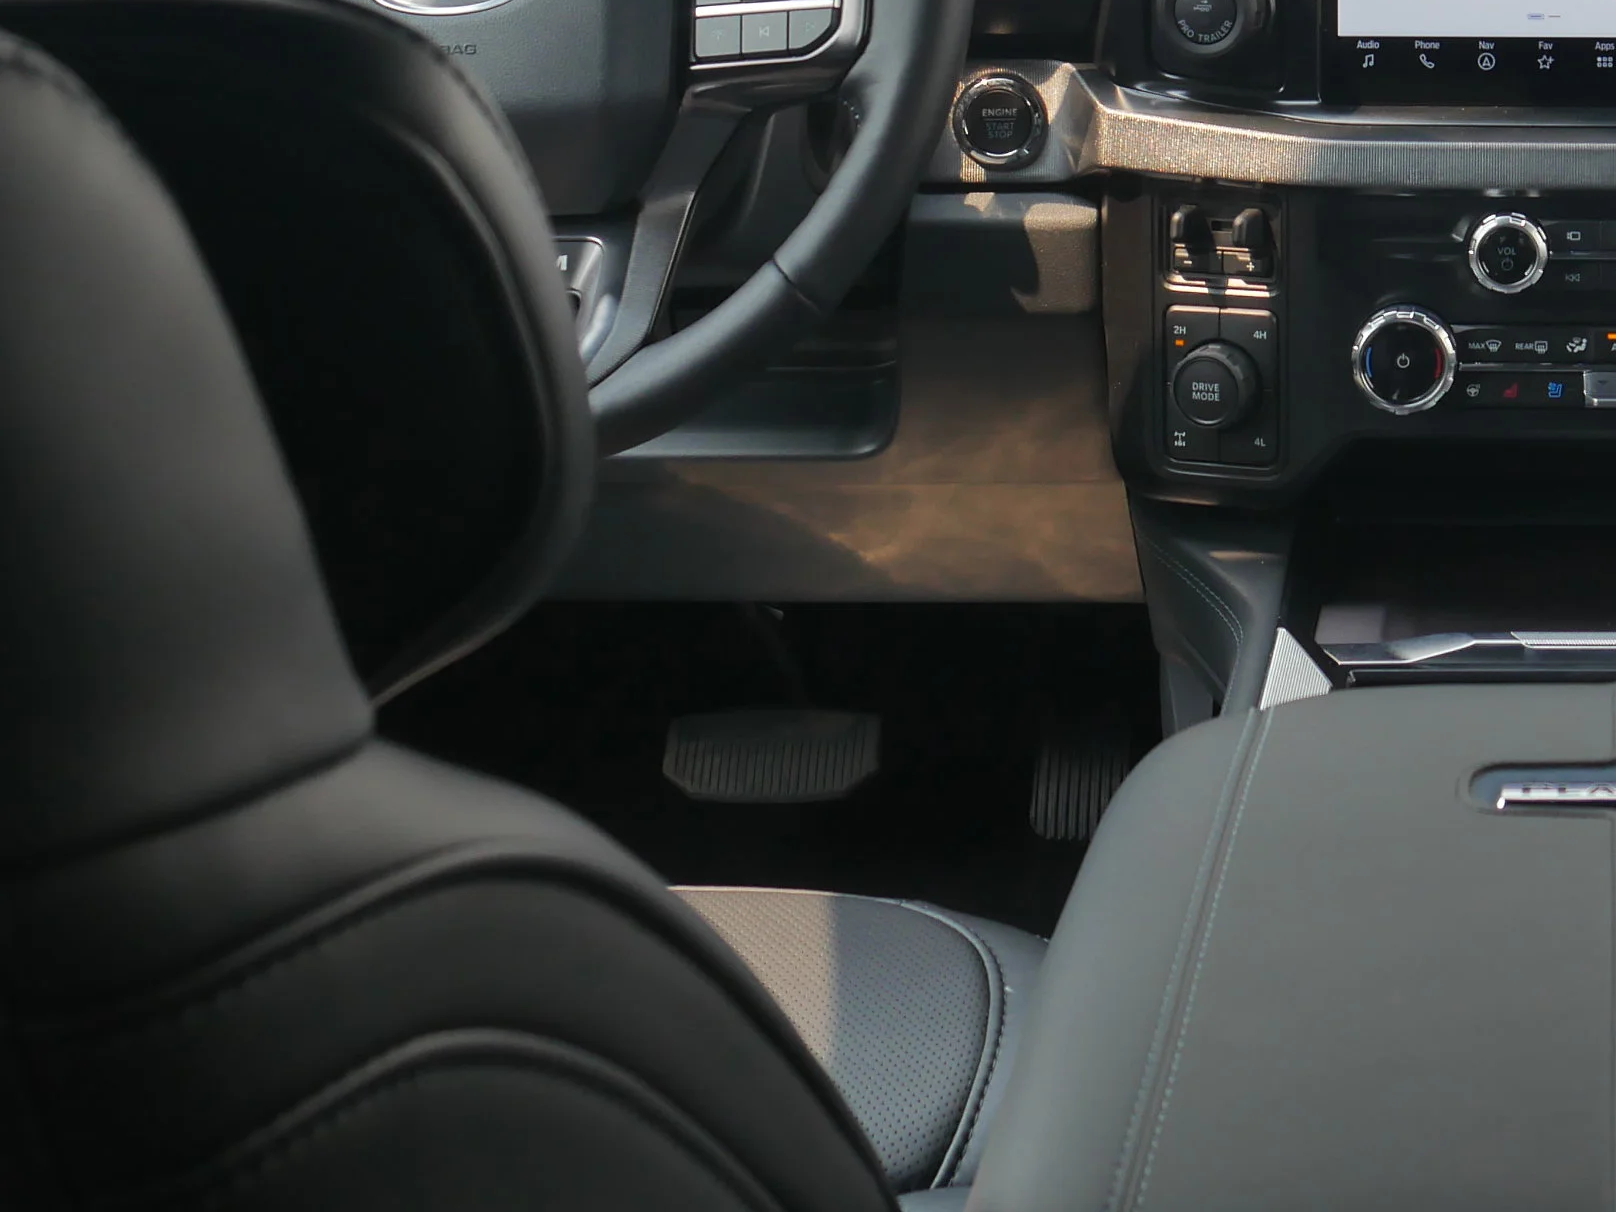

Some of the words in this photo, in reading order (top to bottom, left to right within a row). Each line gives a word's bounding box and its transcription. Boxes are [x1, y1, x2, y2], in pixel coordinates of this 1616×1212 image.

[1178, 19, 1195, 38] PRO
[1198, 20, 1233, 43] TRAILER
[1356, 40, 1380, 50] Audio
[1414, 40, 1440, 50] Phone
[1478, 40, 1495, 50] Nav
[1538, 41, 1553, 51] Fav
[1595, 41, 1615, 53] Apps
[982, 108, 1018, 117] ENGINE
[986, 122, 1014, 130] START
[988, 131, 1013, 139] STOP
[1498, 247, 1516, 256] VOL
[1173, 325, 1187, 335] 2H
[1253, 329, 1268, 340] 4H
[1468, 342, 1486, 351] MAX
[1514, 342, 1534, 351] REAR
[1191, 382, 1220, 391] DRIVE
[1192, 391, 1220, 401] MODE
[1254, 436, 1266, 447] 4L
